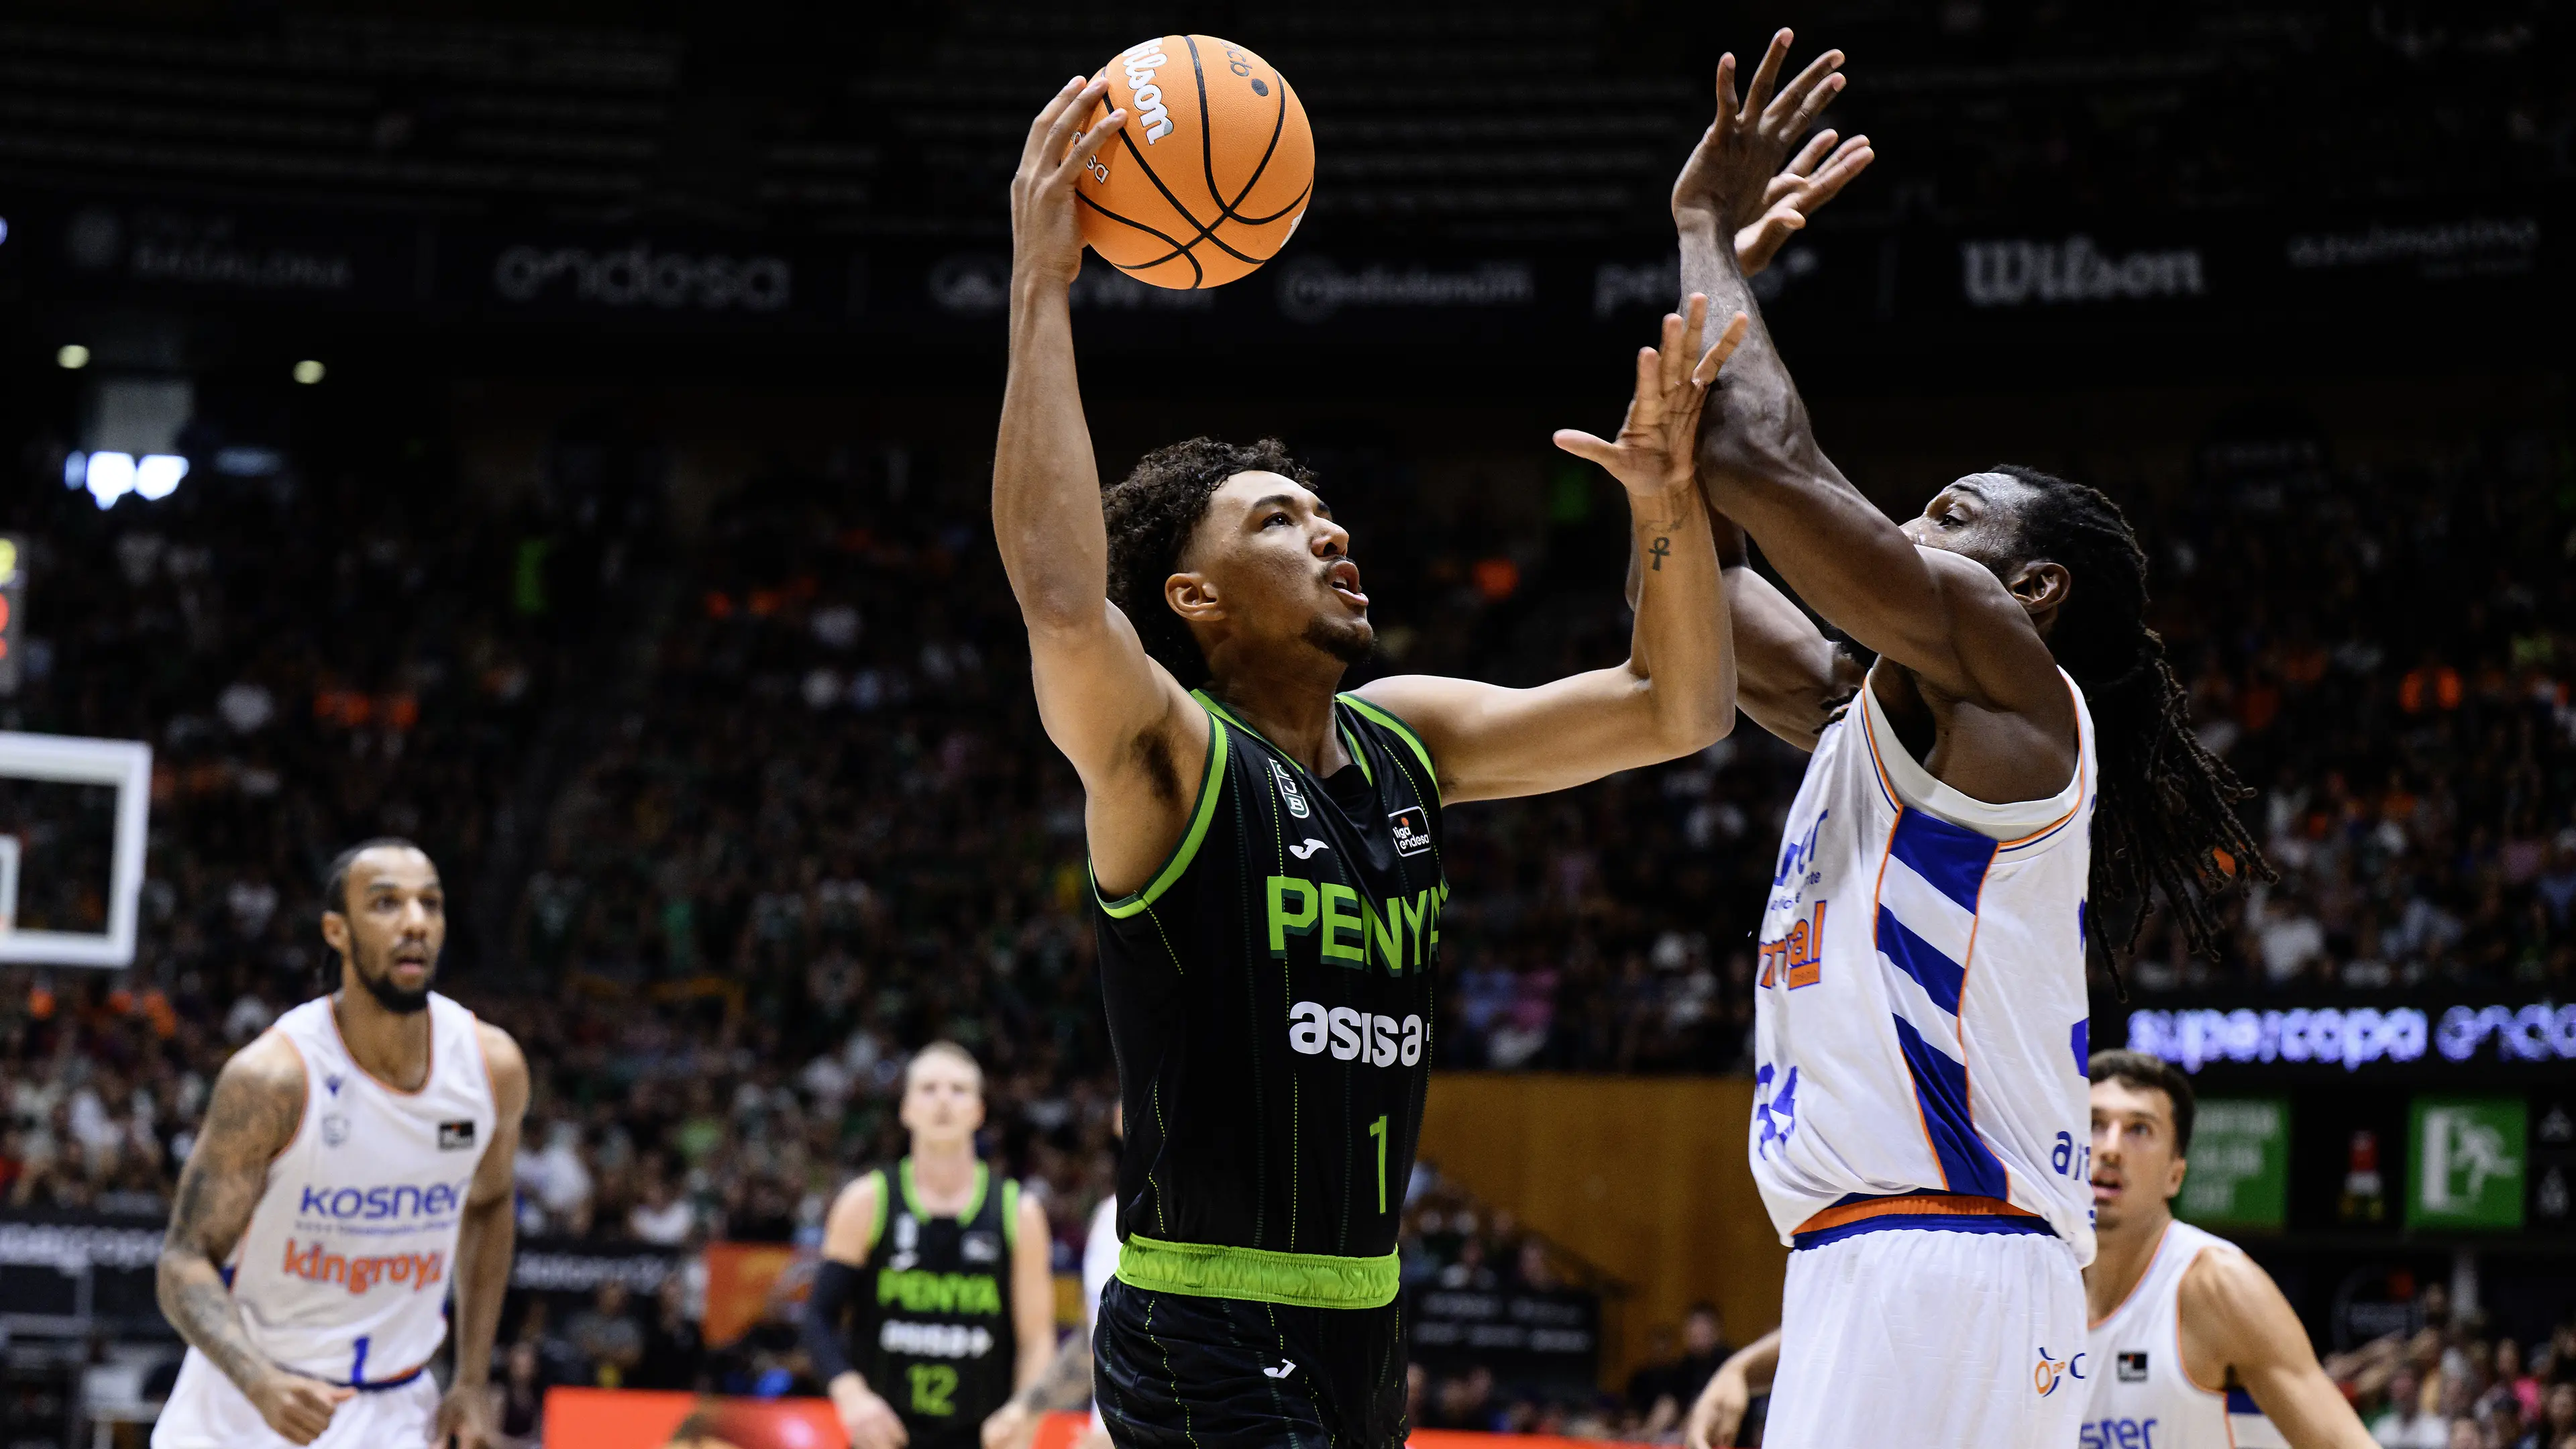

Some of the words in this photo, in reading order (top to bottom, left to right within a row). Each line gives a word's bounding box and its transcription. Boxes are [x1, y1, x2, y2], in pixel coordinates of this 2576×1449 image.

[493, 236, 793, 311] endesa
[1959, 231, 2210, 307] Wilson
[1392, 826, 1411, 839] liga
[1399, 834, 1430, 850] endesa
[1289, 1002, 1423, 1068] asisa
[1369, 1114, 1389, 1216] 1
[350, 1336, 370, 1383] 1
[905, 1363, 960, 1417] 12
